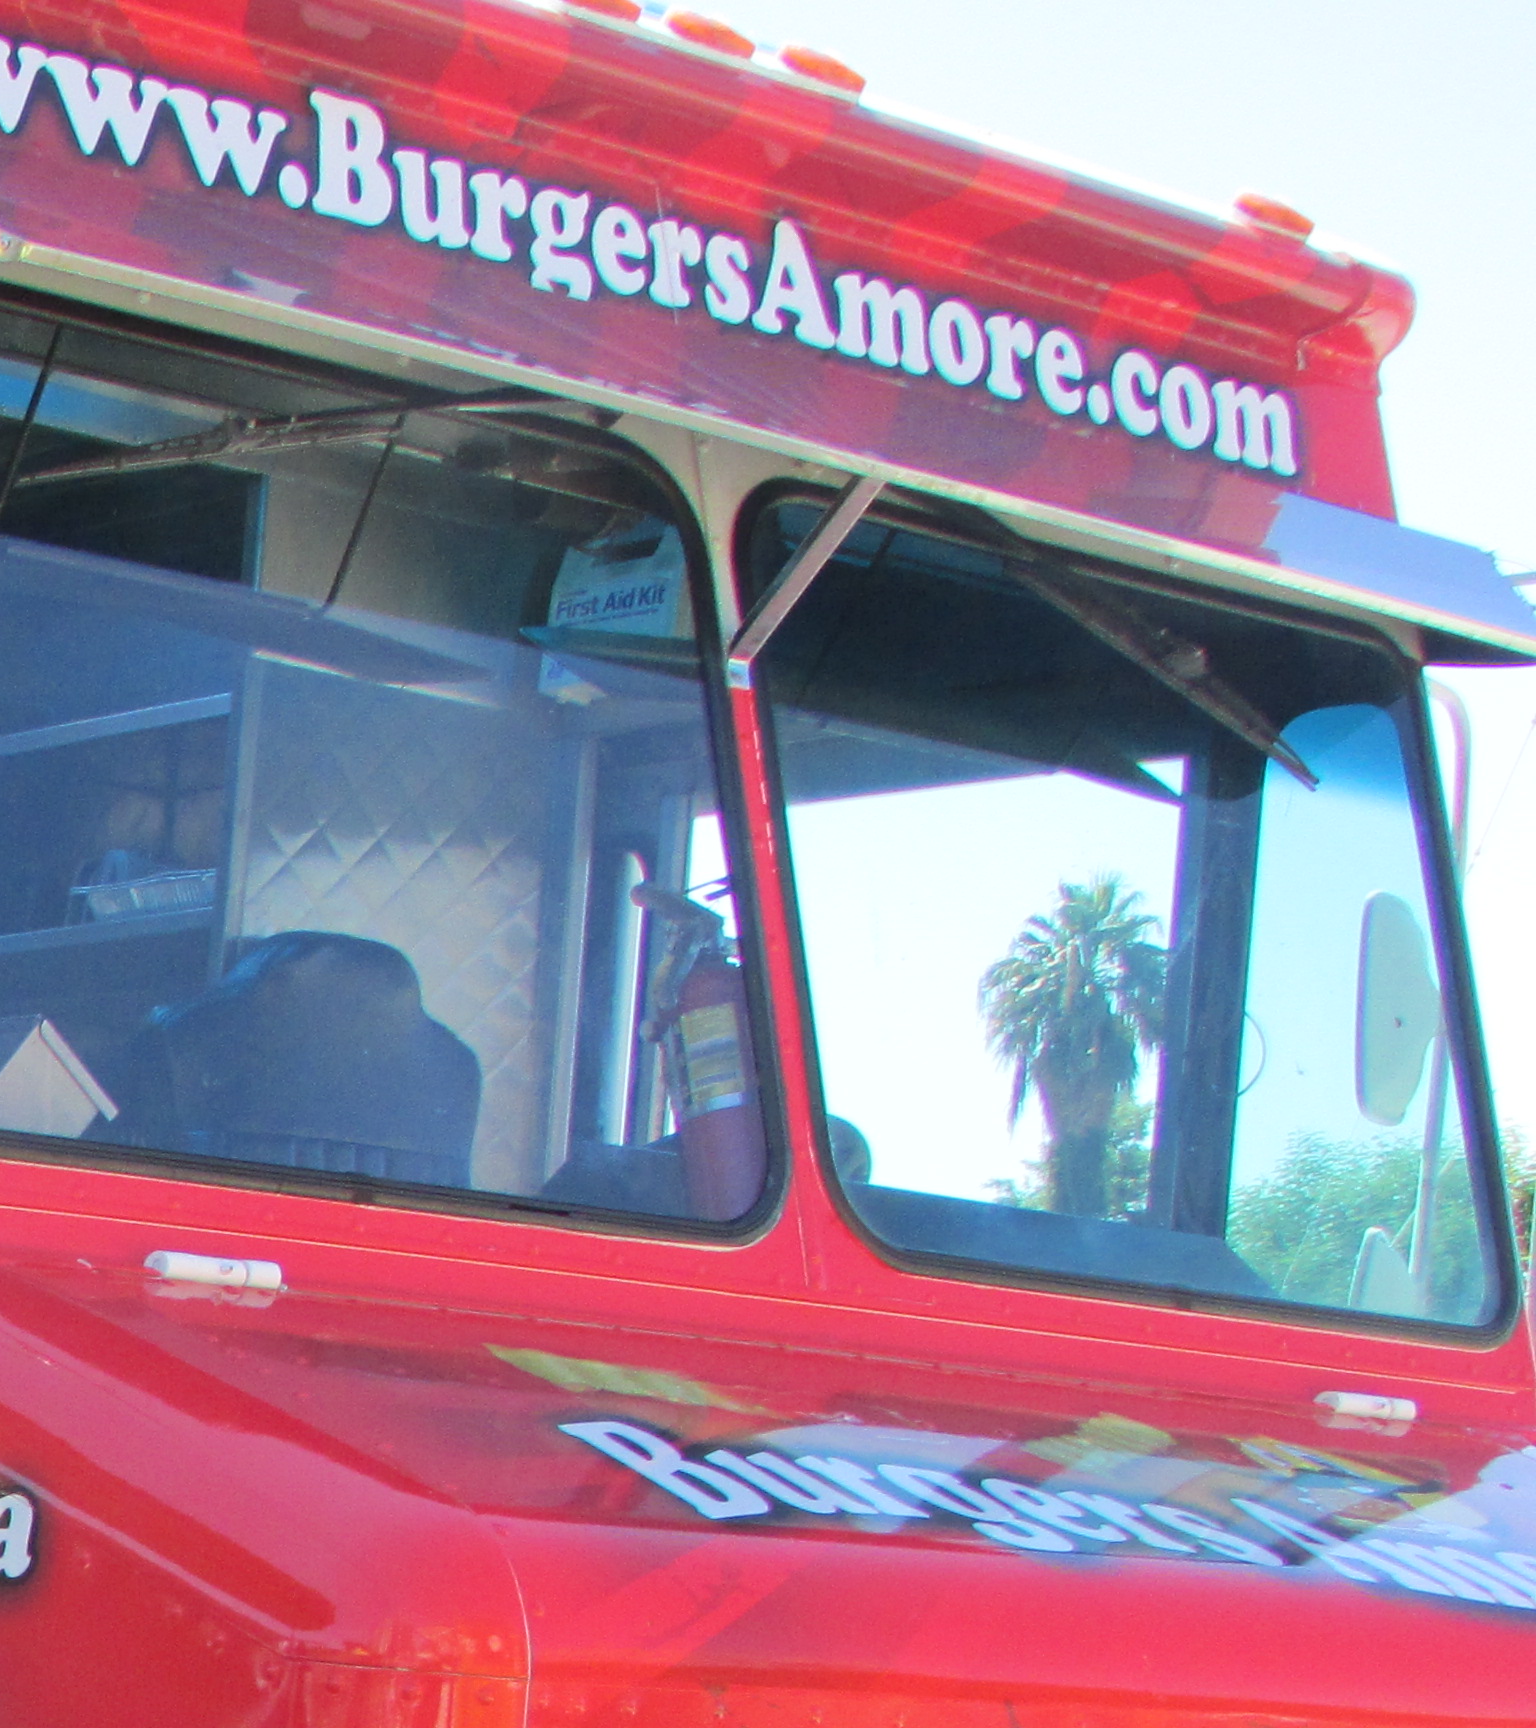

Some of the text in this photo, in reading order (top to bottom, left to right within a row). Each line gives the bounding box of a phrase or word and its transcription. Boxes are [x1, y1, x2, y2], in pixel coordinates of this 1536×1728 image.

[556, 585, 666, 620] First Aid Kit
